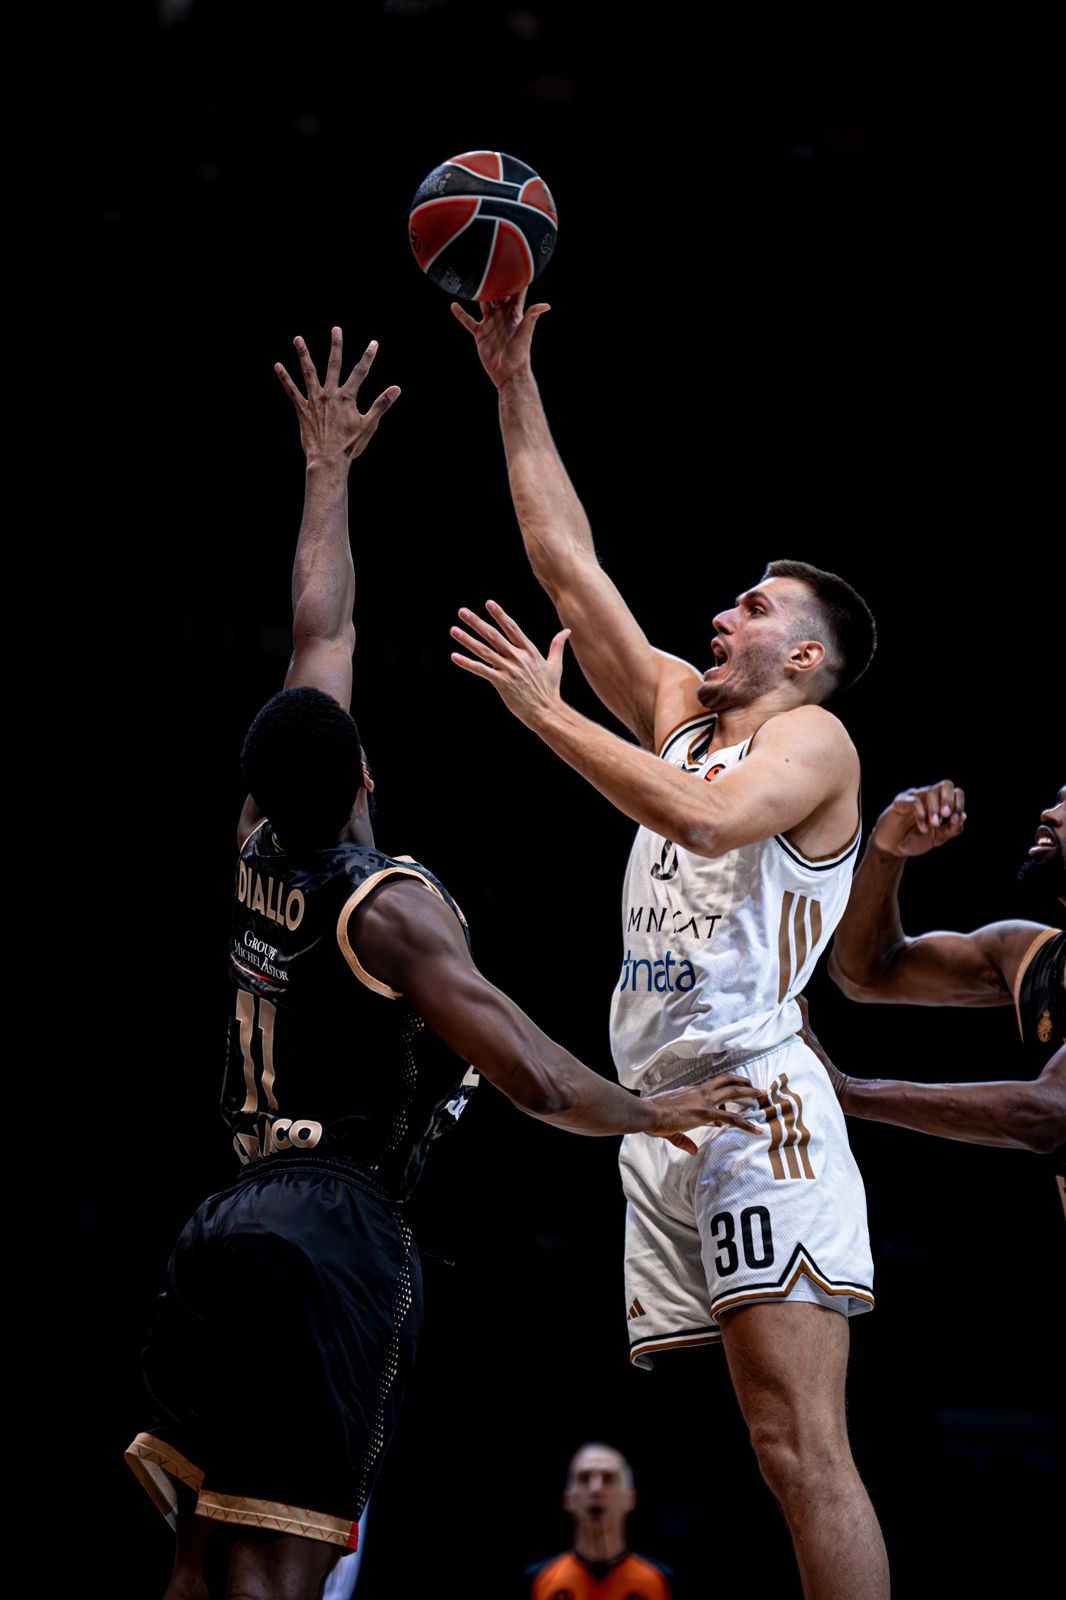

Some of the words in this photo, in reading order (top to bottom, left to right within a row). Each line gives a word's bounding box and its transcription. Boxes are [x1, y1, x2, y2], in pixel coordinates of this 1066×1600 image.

[238, 859, 305, 931] DIALLO
[260, 957, 289, 981] ASTOR
[236, 988, 279, 1112] 11
[710, 1205, 775, 1277] 30
